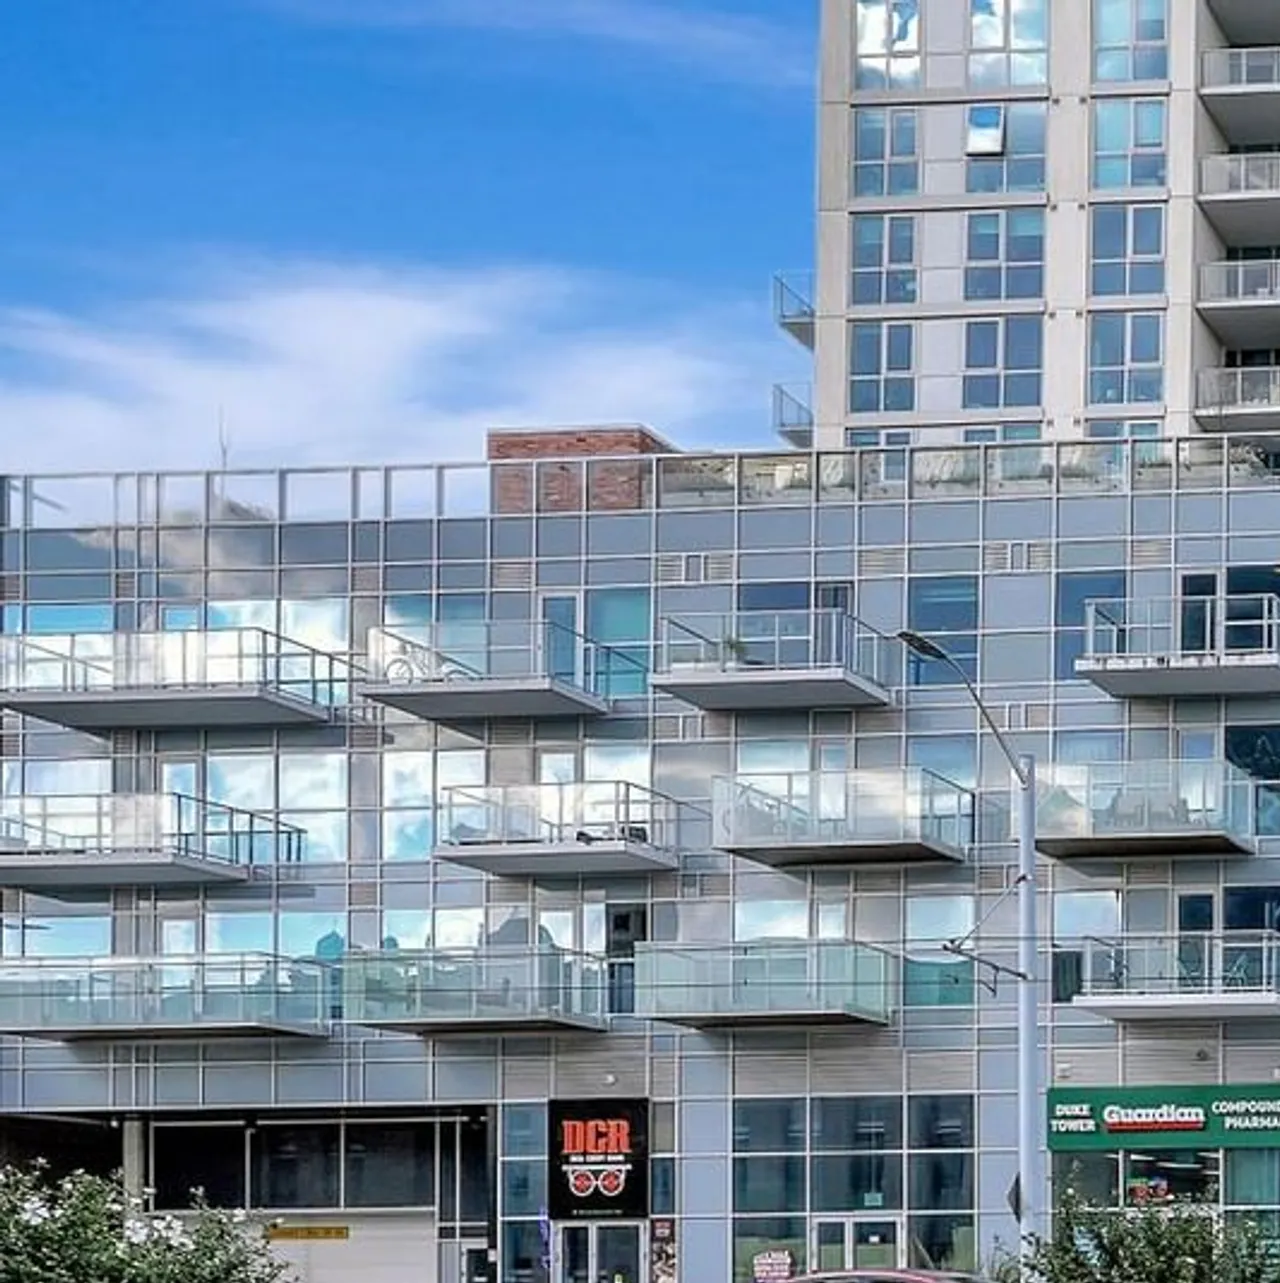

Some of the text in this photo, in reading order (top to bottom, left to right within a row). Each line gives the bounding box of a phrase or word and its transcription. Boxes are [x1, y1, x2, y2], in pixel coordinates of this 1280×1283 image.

[1055, 1104, 1091, 1117] DUKE
[1103, 1104, 1205, 1123] Guardian
[1051, 1119, 1096, 1132] TOWER
[561, 1119, 633, 1154] DCR
